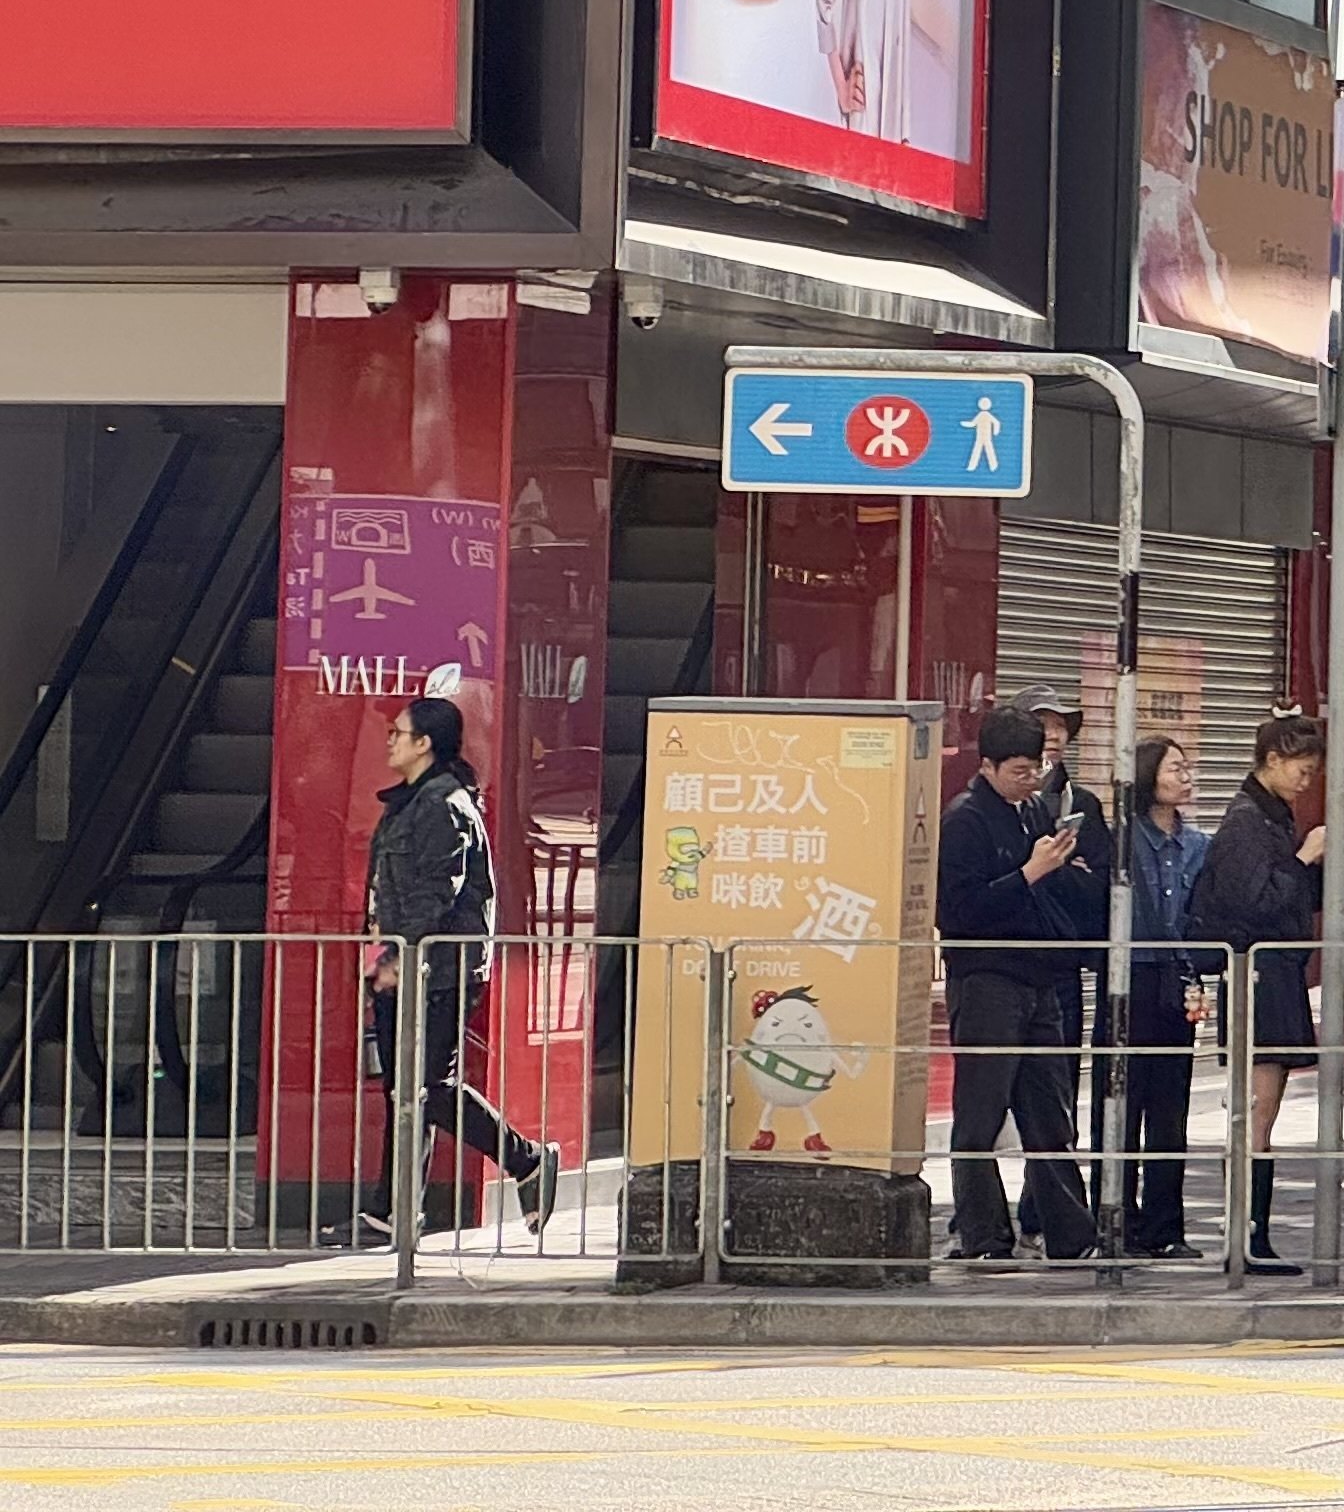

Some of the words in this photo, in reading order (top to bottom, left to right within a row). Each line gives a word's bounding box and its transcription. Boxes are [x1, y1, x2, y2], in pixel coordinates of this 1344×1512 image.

[1185, 90, 1252, 179] SHOP
[1261, 113, 1308, 194] FOR
[316, 656, 418, 696] MALL
[663, 772, 829, 816] 顧己及人
[713, 825, 829, 865] 揸車前
[711, 871, 785, 910] 咪飲
[793, 876, 878, 964] 酒
[746, 961, 801, 978] DRIVE
